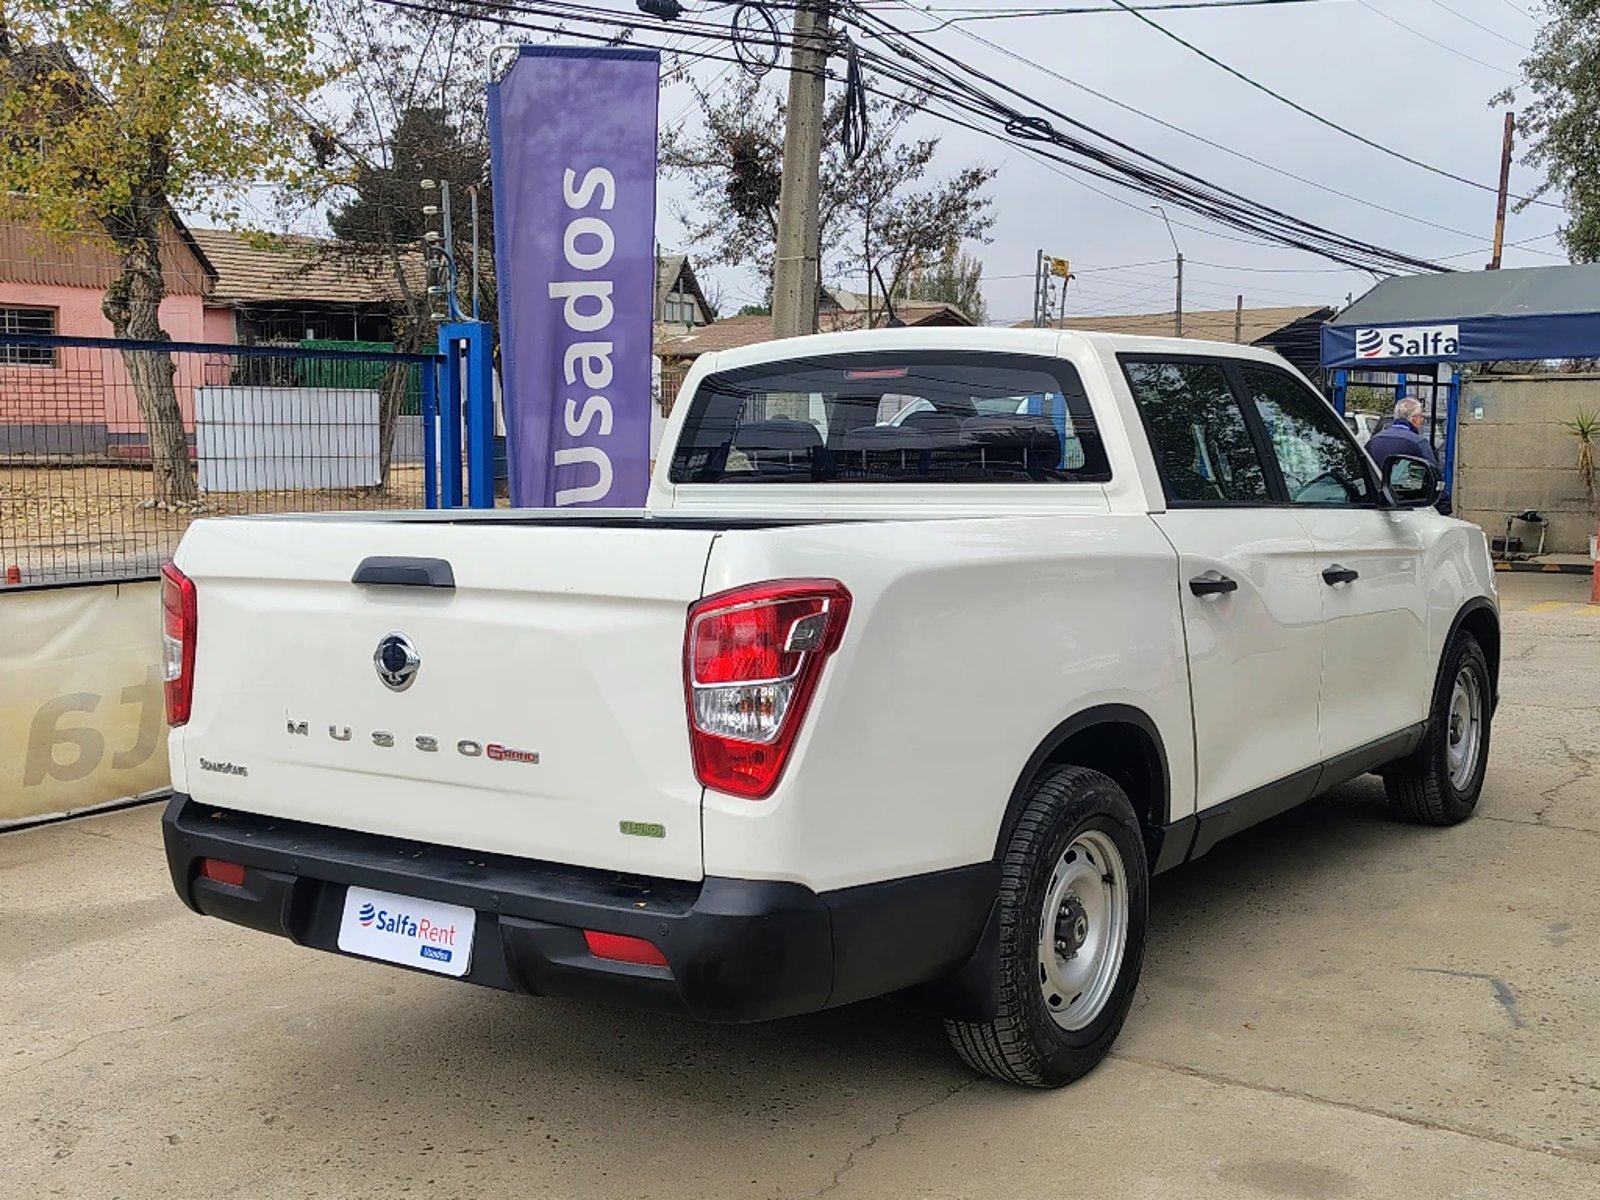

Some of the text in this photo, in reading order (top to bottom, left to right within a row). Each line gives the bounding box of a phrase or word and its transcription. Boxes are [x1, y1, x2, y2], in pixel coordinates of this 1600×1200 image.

[548, 166, 616, 507] Usados
[1388, 332, 1458, 356] Salfa
[286, 719, 483, 758] MUSSO
